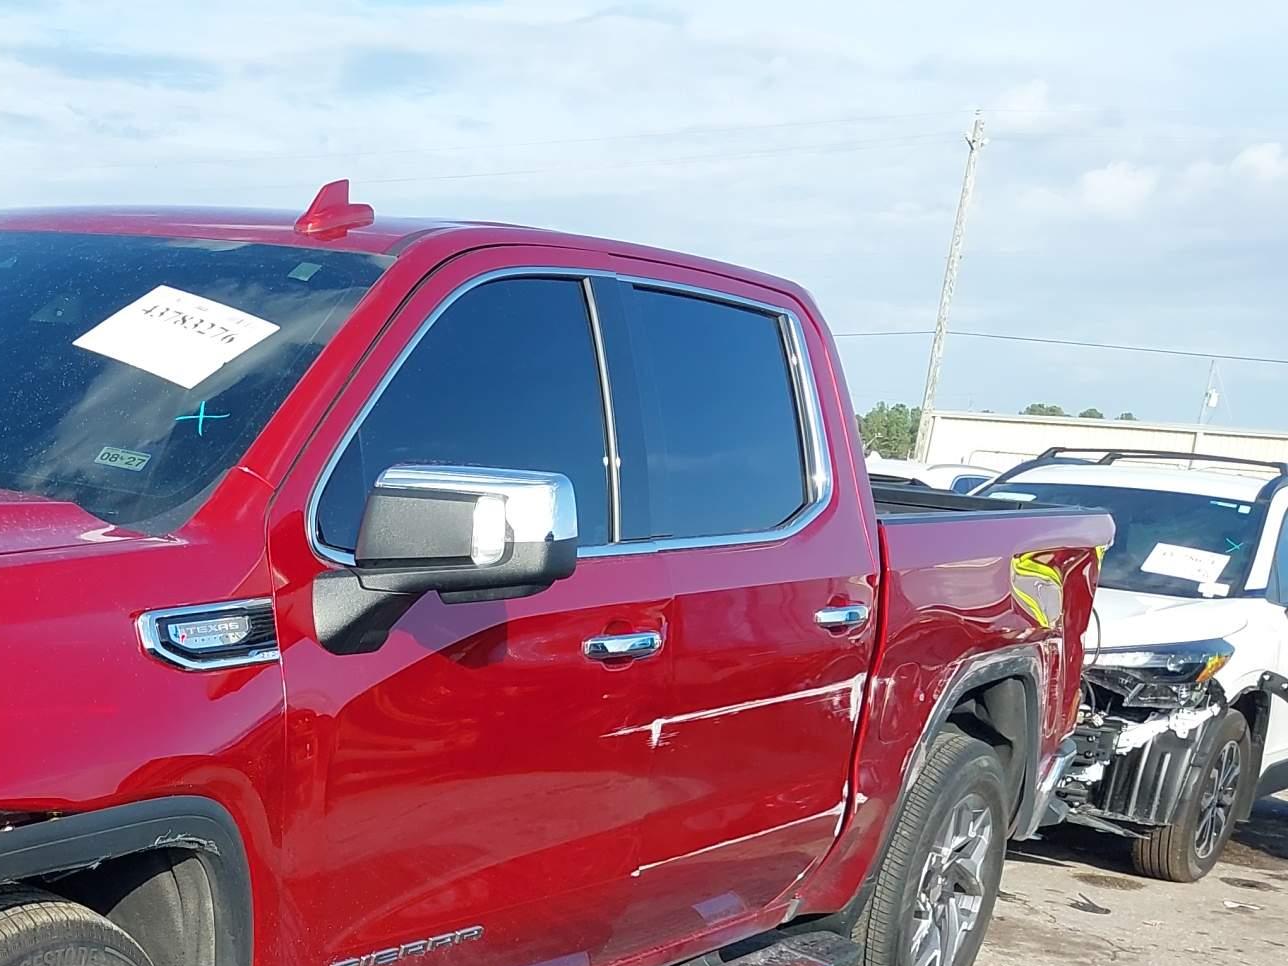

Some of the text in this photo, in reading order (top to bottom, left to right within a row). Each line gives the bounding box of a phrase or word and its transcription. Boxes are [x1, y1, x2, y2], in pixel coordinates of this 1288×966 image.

[141, 304, 236, 345] 43783276
[100, 452, 146, 467] 08 27
[185, 622, 239, 635] TEXAS
